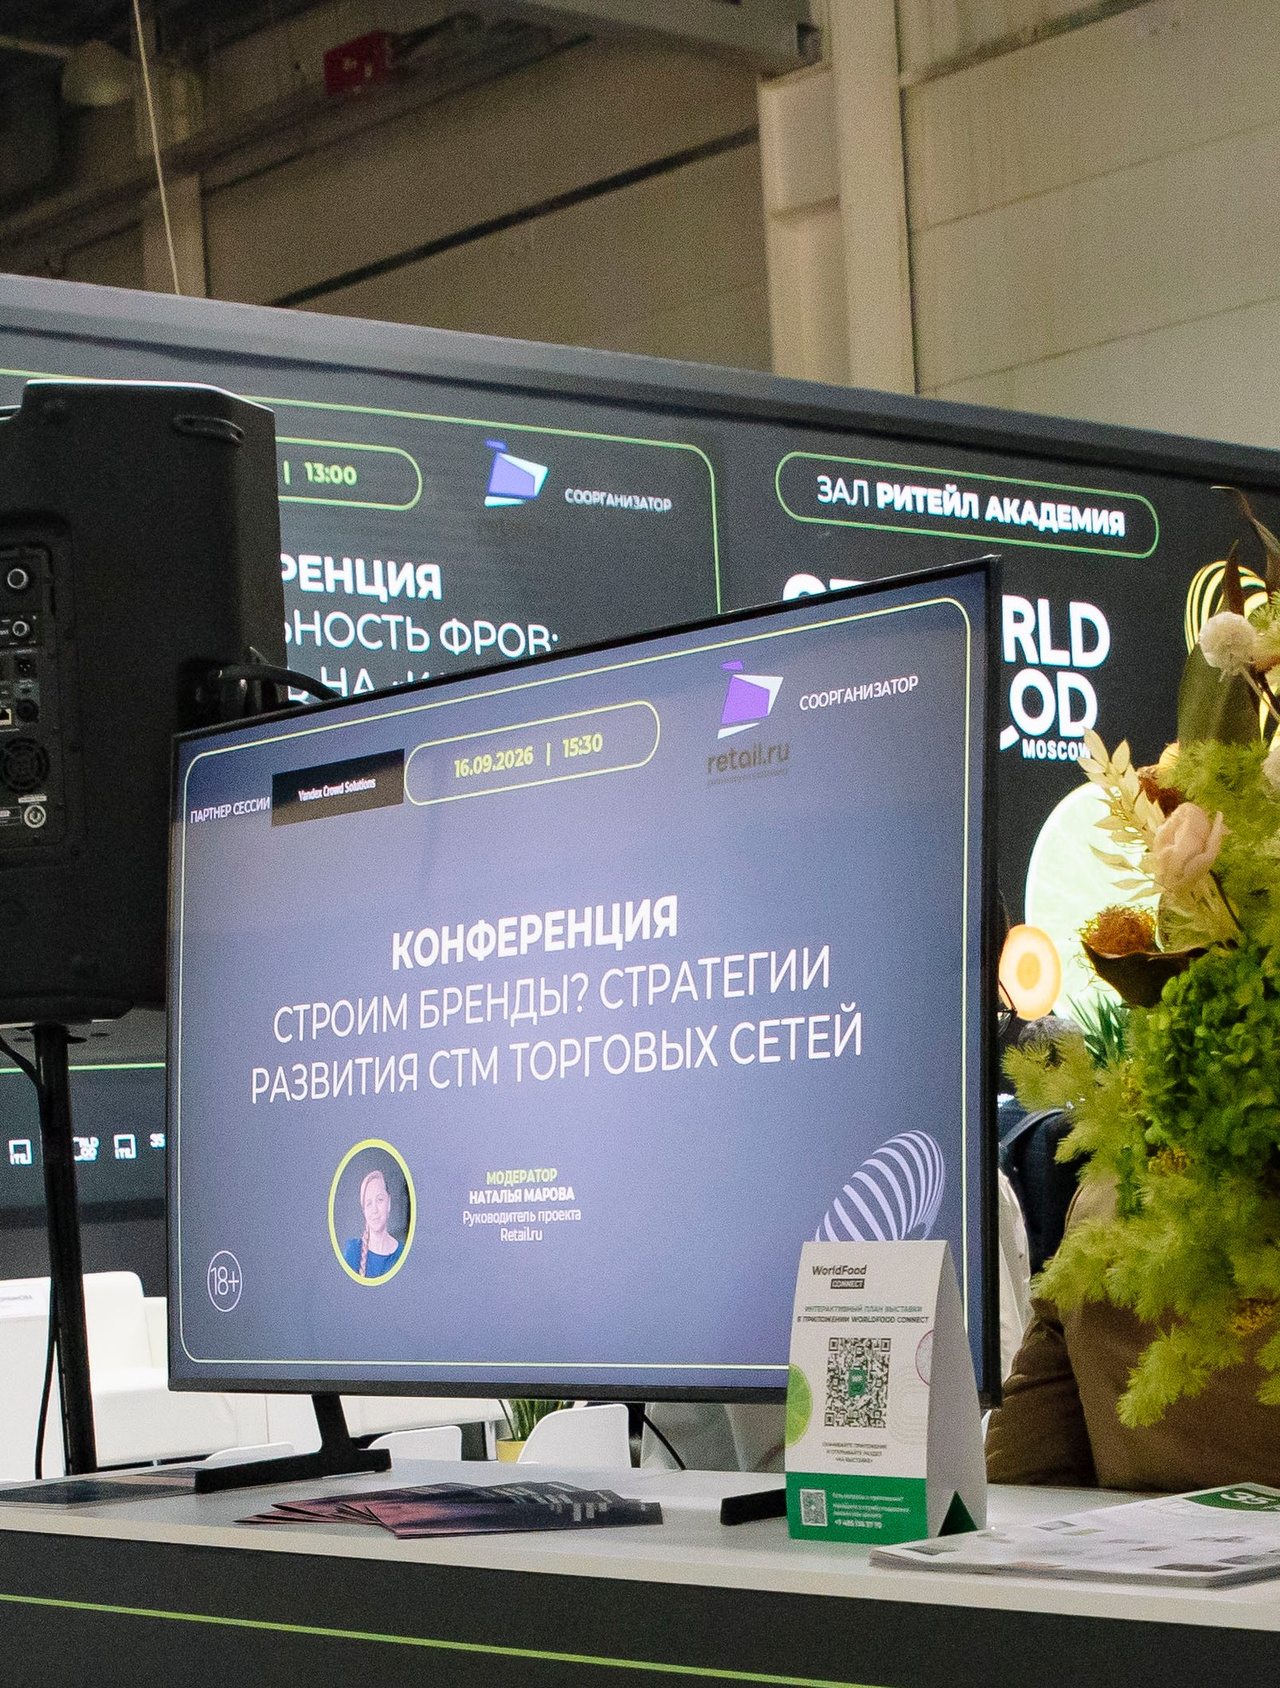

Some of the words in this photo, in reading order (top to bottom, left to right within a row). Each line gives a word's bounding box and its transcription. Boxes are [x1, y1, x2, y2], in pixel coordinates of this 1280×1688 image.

[304, 461, 358, 486] 13:00
[565, 488, 673, 513] СООРГАНИЗАТОР
[817, 475, 869, 507] ЗАЛ
[876, 483, 979, 520] РИТЕЙЛ
[984, 495, 1126, 538] АКАДЕМИЯ
[799, 675, 919, 711] СООРГАНИЗАТОР
[454, 745, 534, 779] 16.09.2026
[563, 733, 604, 758] 15:30
[707, 742, 790, 774] retail.ru
[298, 789, 323, 802] Yandex
[323, 784, 344, 798] Crowd
[345, 778, 377, 793] Solutions
[190, 804, 232, 823] ПАРТНЕР
[232, 796, 271, 815] СЕССИИ
[392, 894, 679, 970] КОНФЕРЕНЦИЯ
[273, 993, 409, 1044] СТРОИМ
[419, 973, 588, 1031] БРЕНДЫ?
[600, 945, 831, 1011] СТРАТЕГИИ
[251, 1052, 419, 1106] РАЗВИТИЯ
[428, 1046, 499, 1091] СТМ
[509, 1025, 719, 1083] ТОРГОВЫХ
[729, 1001, 864, 1066] СЕТЕЙ
[486, 1168, 558, 1186] МОДЕРАТОР
[469, 1189, 523, 1204] НАТАЛЬЯ
[524, 1186, 576, 1203] МАРОВА
[462, 1210, 536, 1227] Руководитель
[538, 1209, 582, 1224] проекта
[500, 1227, 543, 1242] Retail.ru
[210, 1266, 239, 1296] 18+
[812, 1265, 867, 1276] WorldFood
[831, 1280, 864, 1288] CONNECT
